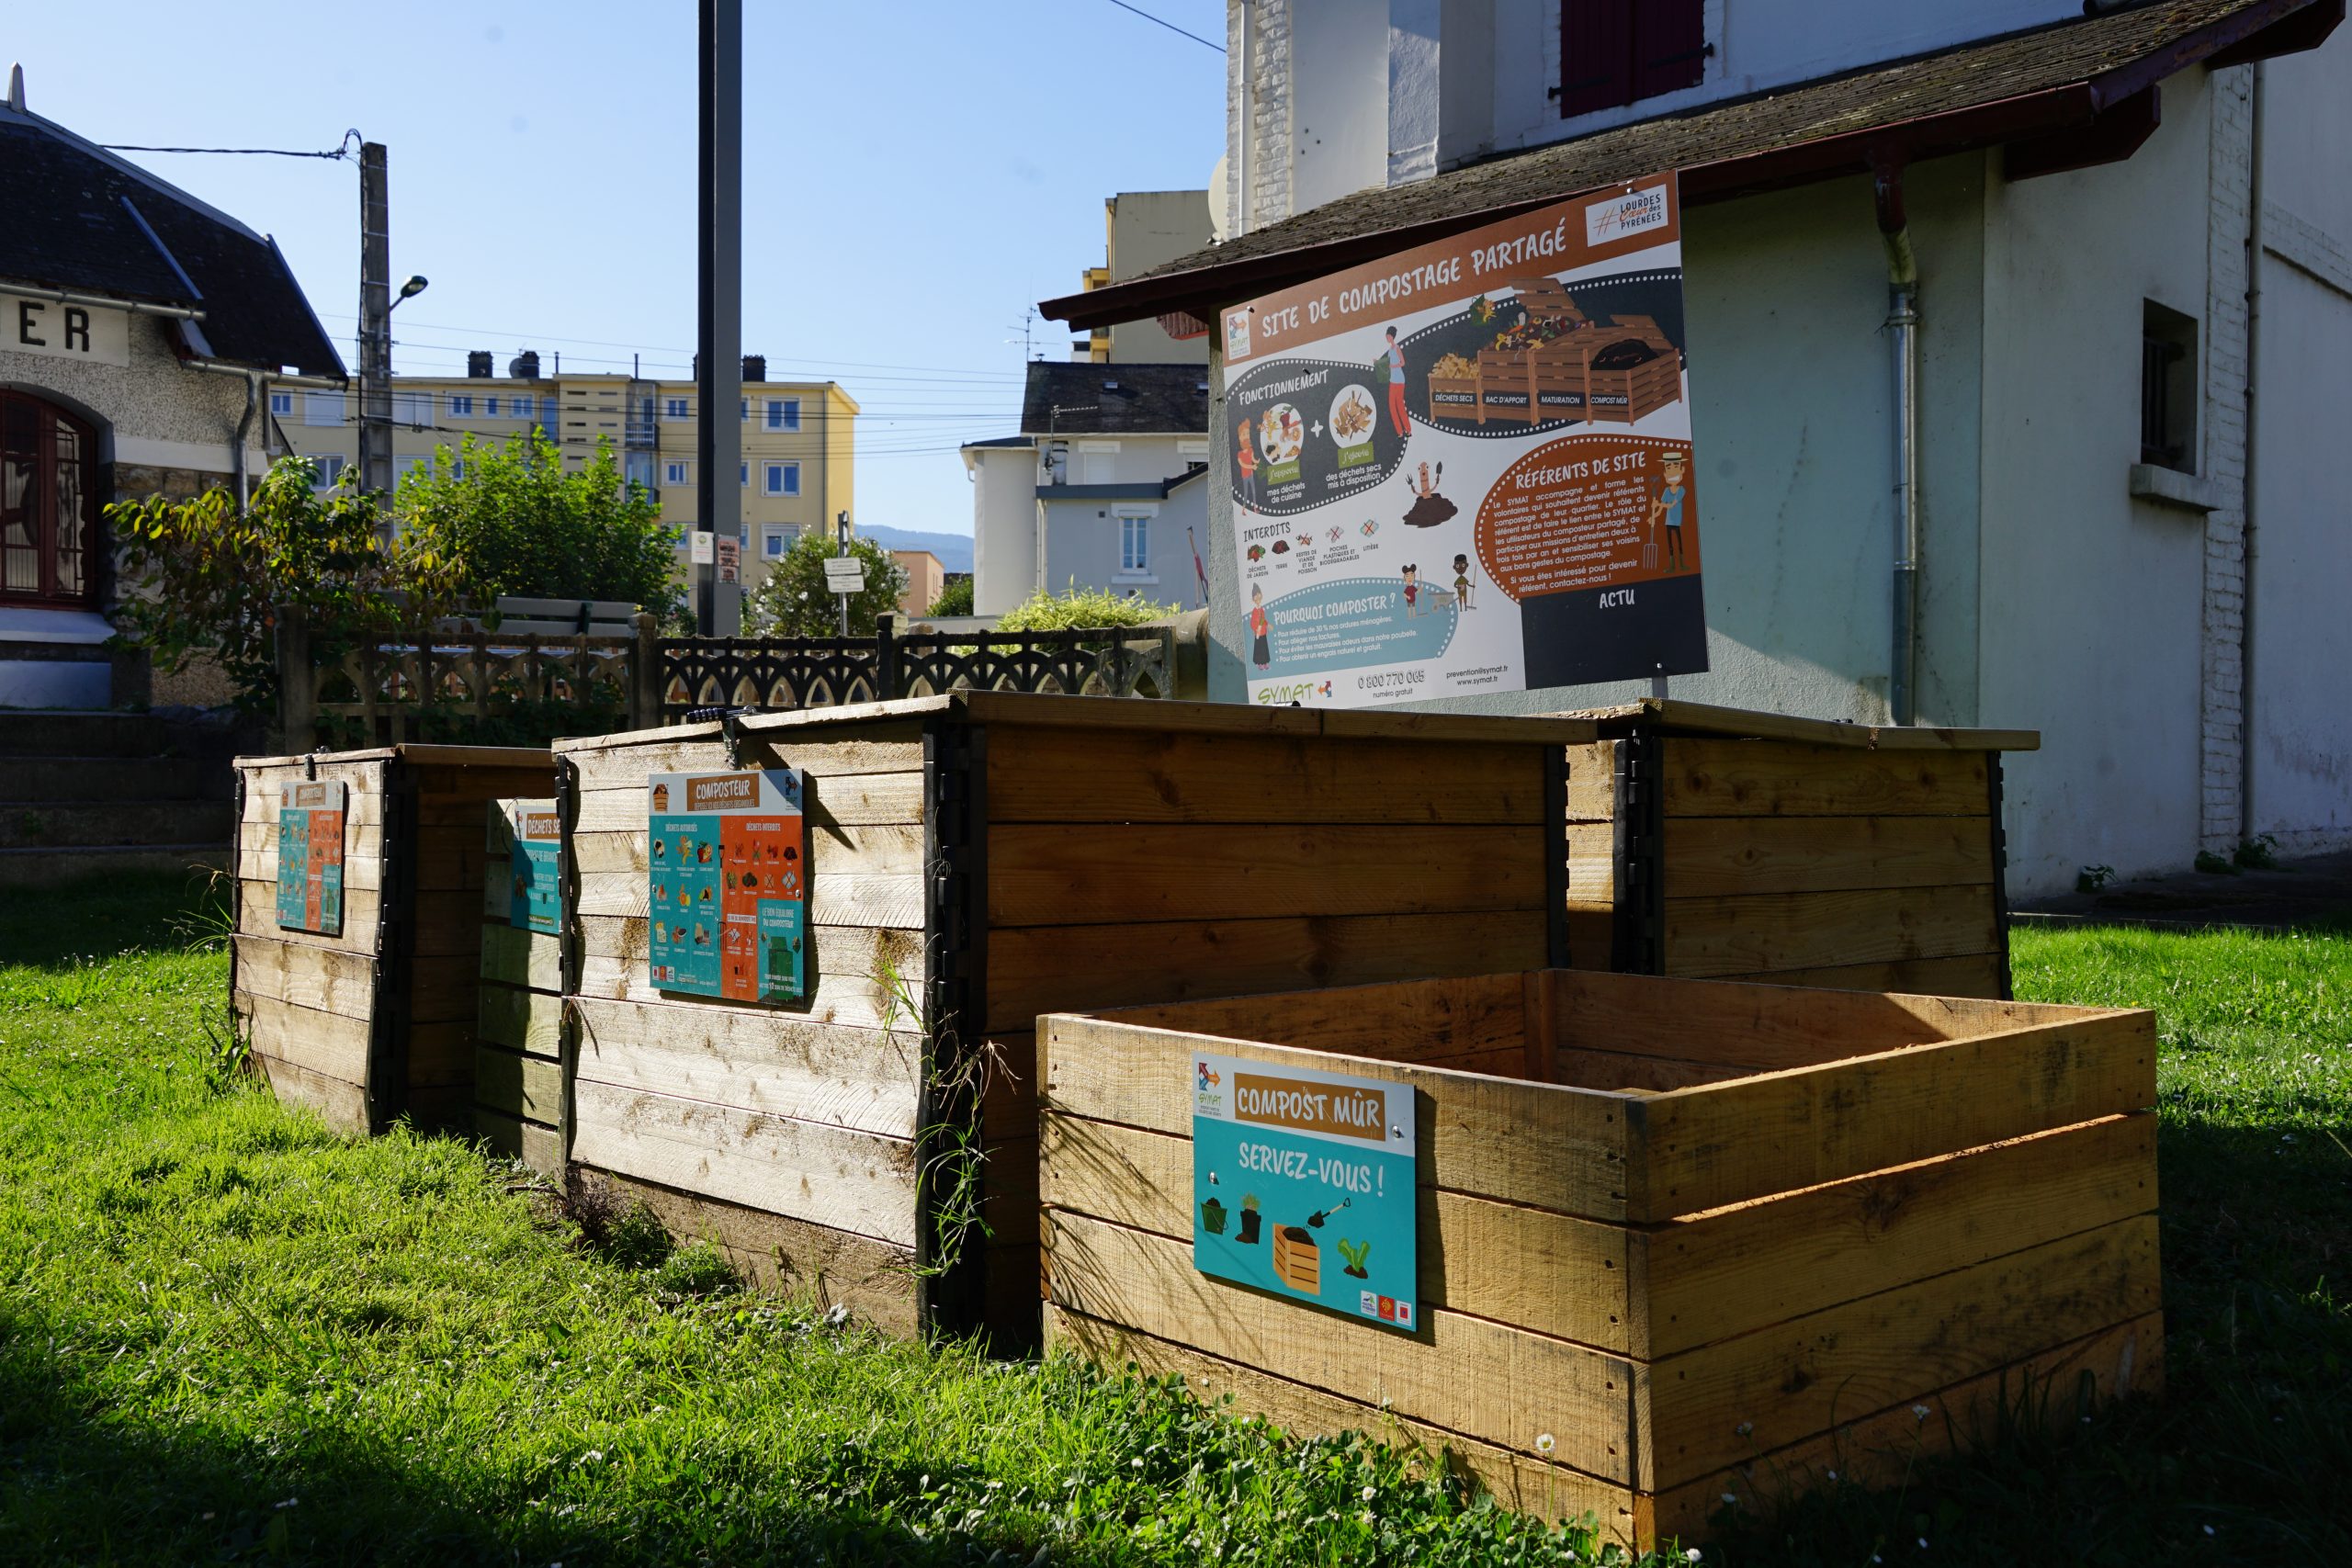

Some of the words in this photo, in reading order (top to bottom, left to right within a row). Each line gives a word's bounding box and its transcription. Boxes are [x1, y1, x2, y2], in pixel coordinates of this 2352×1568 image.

[1621, 194, 1660, 212] LOURDES
[1622, 212, 1661, 230] PYRÉNÉES
[1262, 306, 1299, 337] SITE
[1308, 296, 1329, 324] DE
[1340, 257, 1462, 313] COMPOSTAGE
[1471, 217, 1566, 275] PARTAGÉ
[1238, 369, 1329, 406] FONCTIONNEMENT
[1435, 393, 1458, 401] DÉCHETS
[1326, 473, 1338, 481] des
[1339, 467, 1364, 479] déchets
[1366, 464, 1382, 472] secs
[1328, 480, 1339, 489] mis
[1346, 472, 1380, 485] disposition
[1516, 462, 1589, 490] RÉFÉRENTS
[1592, 458, 1610, 476] DE
[1613, 452, 1646, 472] SITE
[1281, 482, 1305, 493] déchets
[1281, 491, 1302, 501] cuisine
[1508, 496, 1529, 506] SYMAT
[1536, 487, 1583, 501] accompagne
[1605, 479, 1626, 489] forme
[1494, 506, 1529, 518] volontaires
[1532, 503, 1543, 513] qui
[1545, 497, 1580, 509] souhaitent
[1584, 491, 1610, 502] devenir
[1613, 486, 1645, 497] référents
[1495, 514, 1536, 527] compostage
[1554, 509, 1566, 517] leur
[1571, 504, 1600, 514] quartier.
[1618, 497, 1632, 506] rôle
[1495, 525, 1520, 536] référent
[1544, 520, 1559, 528] faire
[1584, 513, 1601, 522] entre
[1604, 510, 1611, 518] le
[1612, 506, 1636, 517] SYMAT
[1638, 504, 1646, 513] et
[1244, 522, 1290, 542] INTERDITS
[1506, 533, 1540, 544] utilisateurs
[1554, 525, 1595, 536] composteur
[1597, 519, 1628, 530] partagé,
[1496, 544, 1527, 556] participer
[1543, 537, 1571, 547] missions
[1572, 531, 1610, 543] d'entretien
[1512, 553, 1523, 561] fois
[1526, 552, 1537, 560] par
[1562, 542, 1599, 554] sensibiliser
[1616, 536, 1640, 546] voisins
[1323, 550, 1349, 559] PLASTIQUES
[1514, 562, 1530, 570] bons
[1532, 558, 1554, 570] gestes
[1555, 556, 1565, 564] du
[1566, 550, 1613, 563] compostage.
[1510, 576, 1517, 584] Si
[1519, 574, 1535, 583] vous
[1537, 571, 1553, 581] êtes
[1555, 567, 1587, 578] intéressé
[1589, 565, 1606, 575] pour
[1609, 559, 1638, 570] devenir
[1519, 582, 1548, 593] référent,
[1550, 575, 1607, 588] contactez-nous
[1273, 604, 1323, 626] POURQUOI
[1326, 595, 1387, 617] COMPOSTER
[1390, 592, 1396, 608] ?
[1599, 589, 1634, 609] ACTU
[1340, 620, 1359, 628] ordures
[1317, 649, 1336, 658] engrais
[1338, 646, 1355, 654] naturel
[1358, 675, 1364, 689] 0
[1366, 673, 1385, 688] 800
[1386, 671, 1404, 686] 770
[1406, 669, 1425, 683] 065
[1446, 665, 1509, 679] prevention@symat.fr
[1457, 675, 1498, 686] www.symat.fr
[1258, 683, 1313, 705] SYMAT
[1395, 688, 1413, 697] gratuit
[696, 780, 750, 799] COMPOSTEUR
[527, 816, 551, 834] DÉCHETS
[1238, 1087, 1329, 1122] COMPOST
[1334, 1090, 1381, 1128] MÛR
[1238, 1142, 1372, 1194] SERVEZ-VOUS
[1377, 1166, 1384, 1197] !
